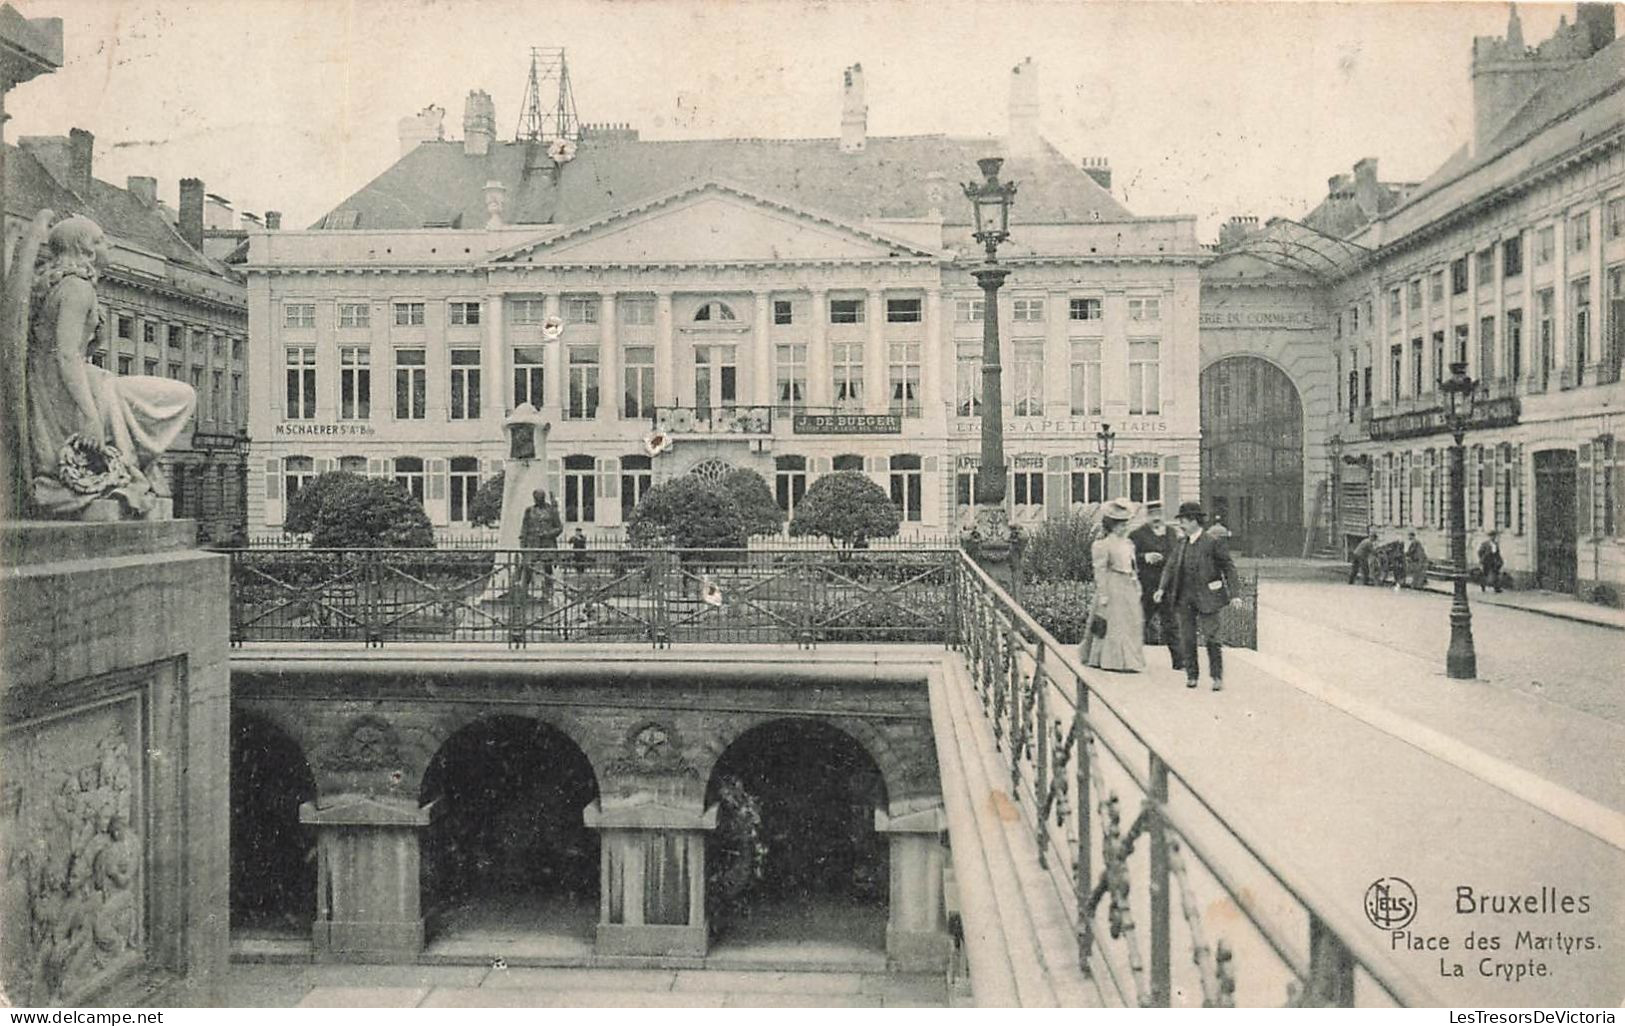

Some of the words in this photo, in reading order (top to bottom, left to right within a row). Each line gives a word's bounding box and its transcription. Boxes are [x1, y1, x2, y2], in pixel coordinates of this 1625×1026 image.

[816, 417, 833, 426] DE
[838, 416, 895, 426] BUEGER
[1024, 422, 1034, 432] A
[1042, 421, 1100, 432] PETIT
[1121, 422, 1167, 431] TAPIS
[1074, 457, 1098, 468] TAPIS
